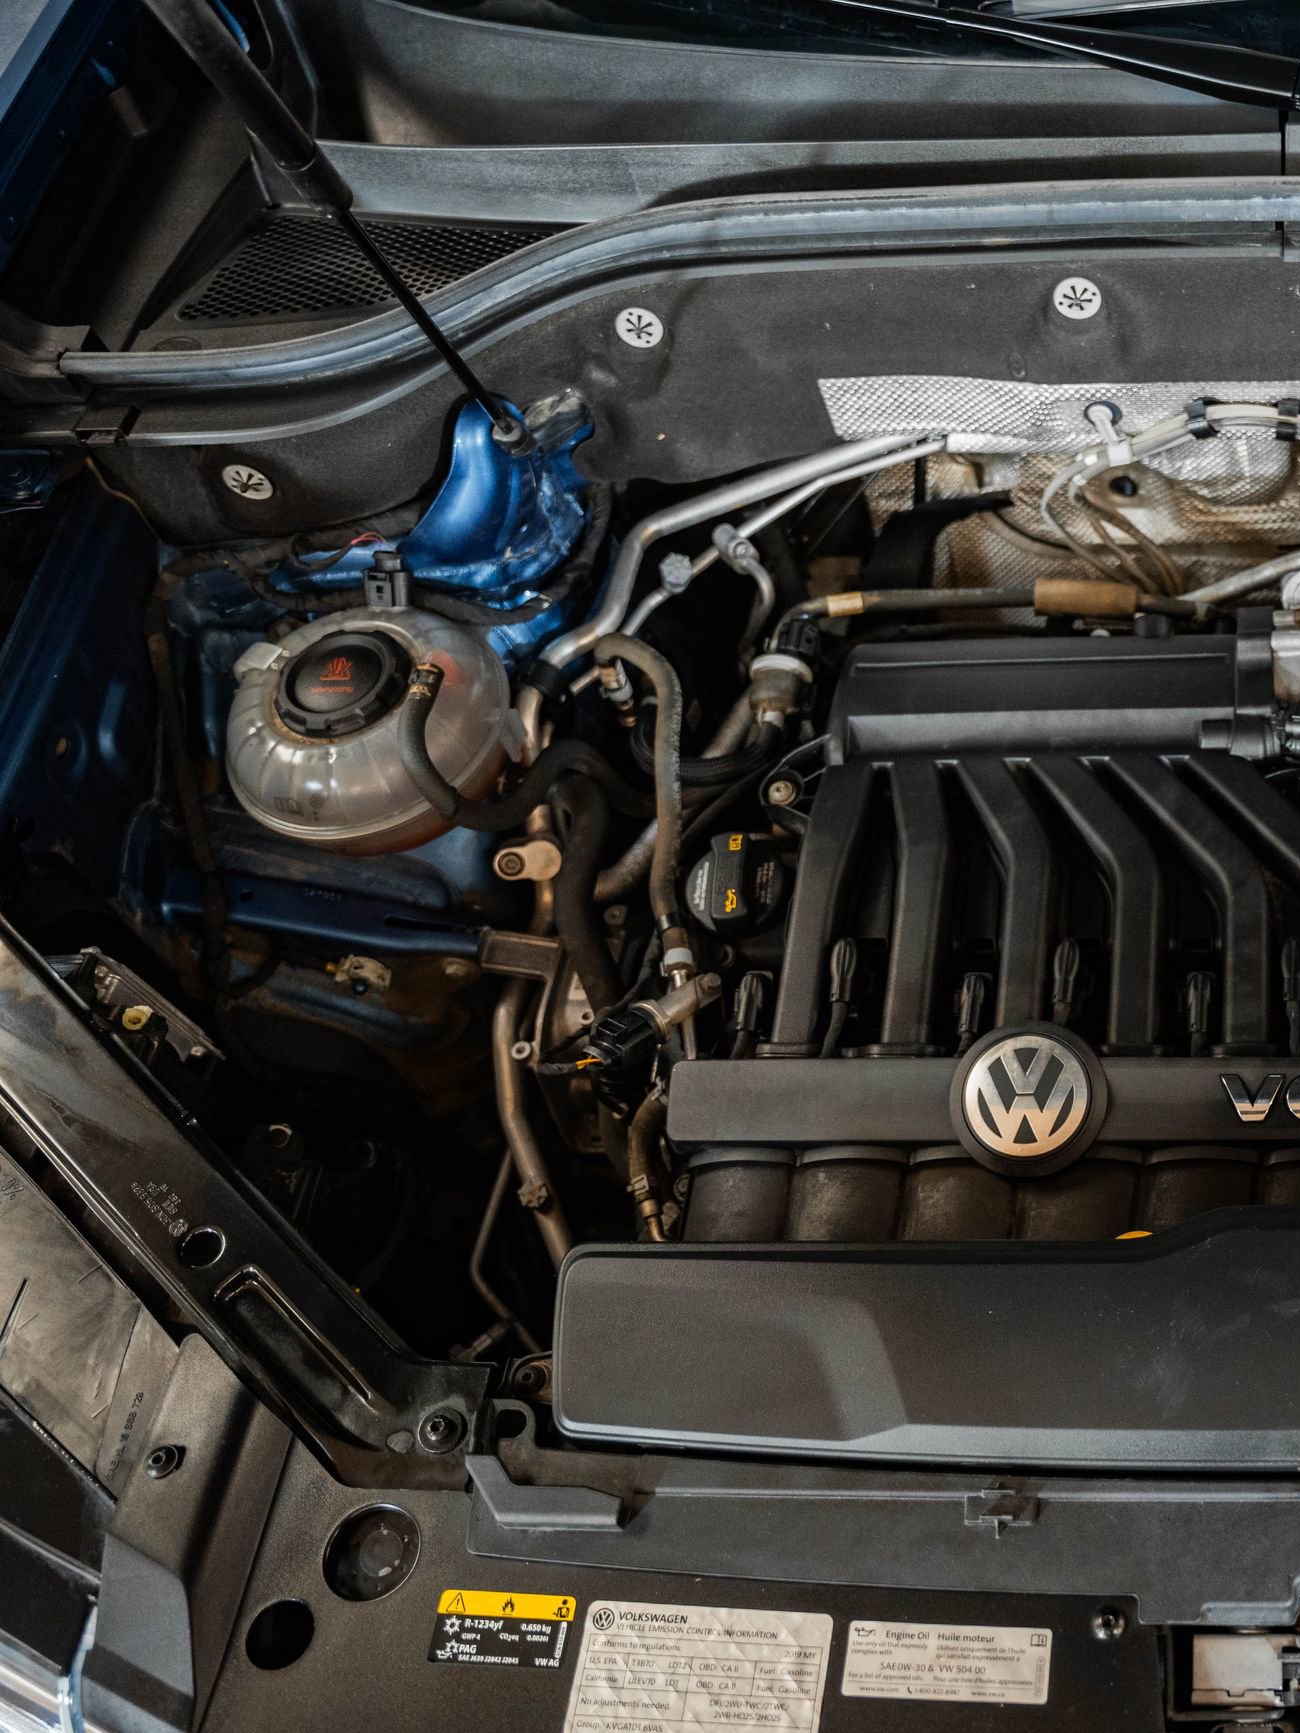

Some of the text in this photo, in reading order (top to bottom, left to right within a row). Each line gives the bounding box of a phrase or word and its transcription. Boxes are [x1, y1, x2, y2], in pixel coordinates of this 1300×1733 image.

[619, 1612, 688, 1624] VOLKSWAGEN
[464, 1620, 551, 1634] R-1234yf 0.650 kg
[617, 1623, 645, 1631] VEHICLE
[648, 1625, 684, 1634] EMISSION
[724, 1630, 778, 1639] INFORMATION
[886, 1630, 915, 1640] Engine
[938, 1633, 960, 1641] Huile
[592, 1639, 627, 1648] Cnforms
[459, 1644, 476, 1654] PAG
[784, 1650, 817, 1659] 2019 MY
[535, 1658, 547, 1666] VW
[549, 1659, 559, 1667] AG
[722, 1664, 732, 1672] CA
[781, 1668, 813, 1677] Gasoline
[939, 1665, 954, 1673] VW
[975, 1666, 986, 1674] 00
[719, 1682, 729, 1690] CA
[778, 1685, 811, 1695] Gasoline
[593, 1698, 640, 1708] adjustments
